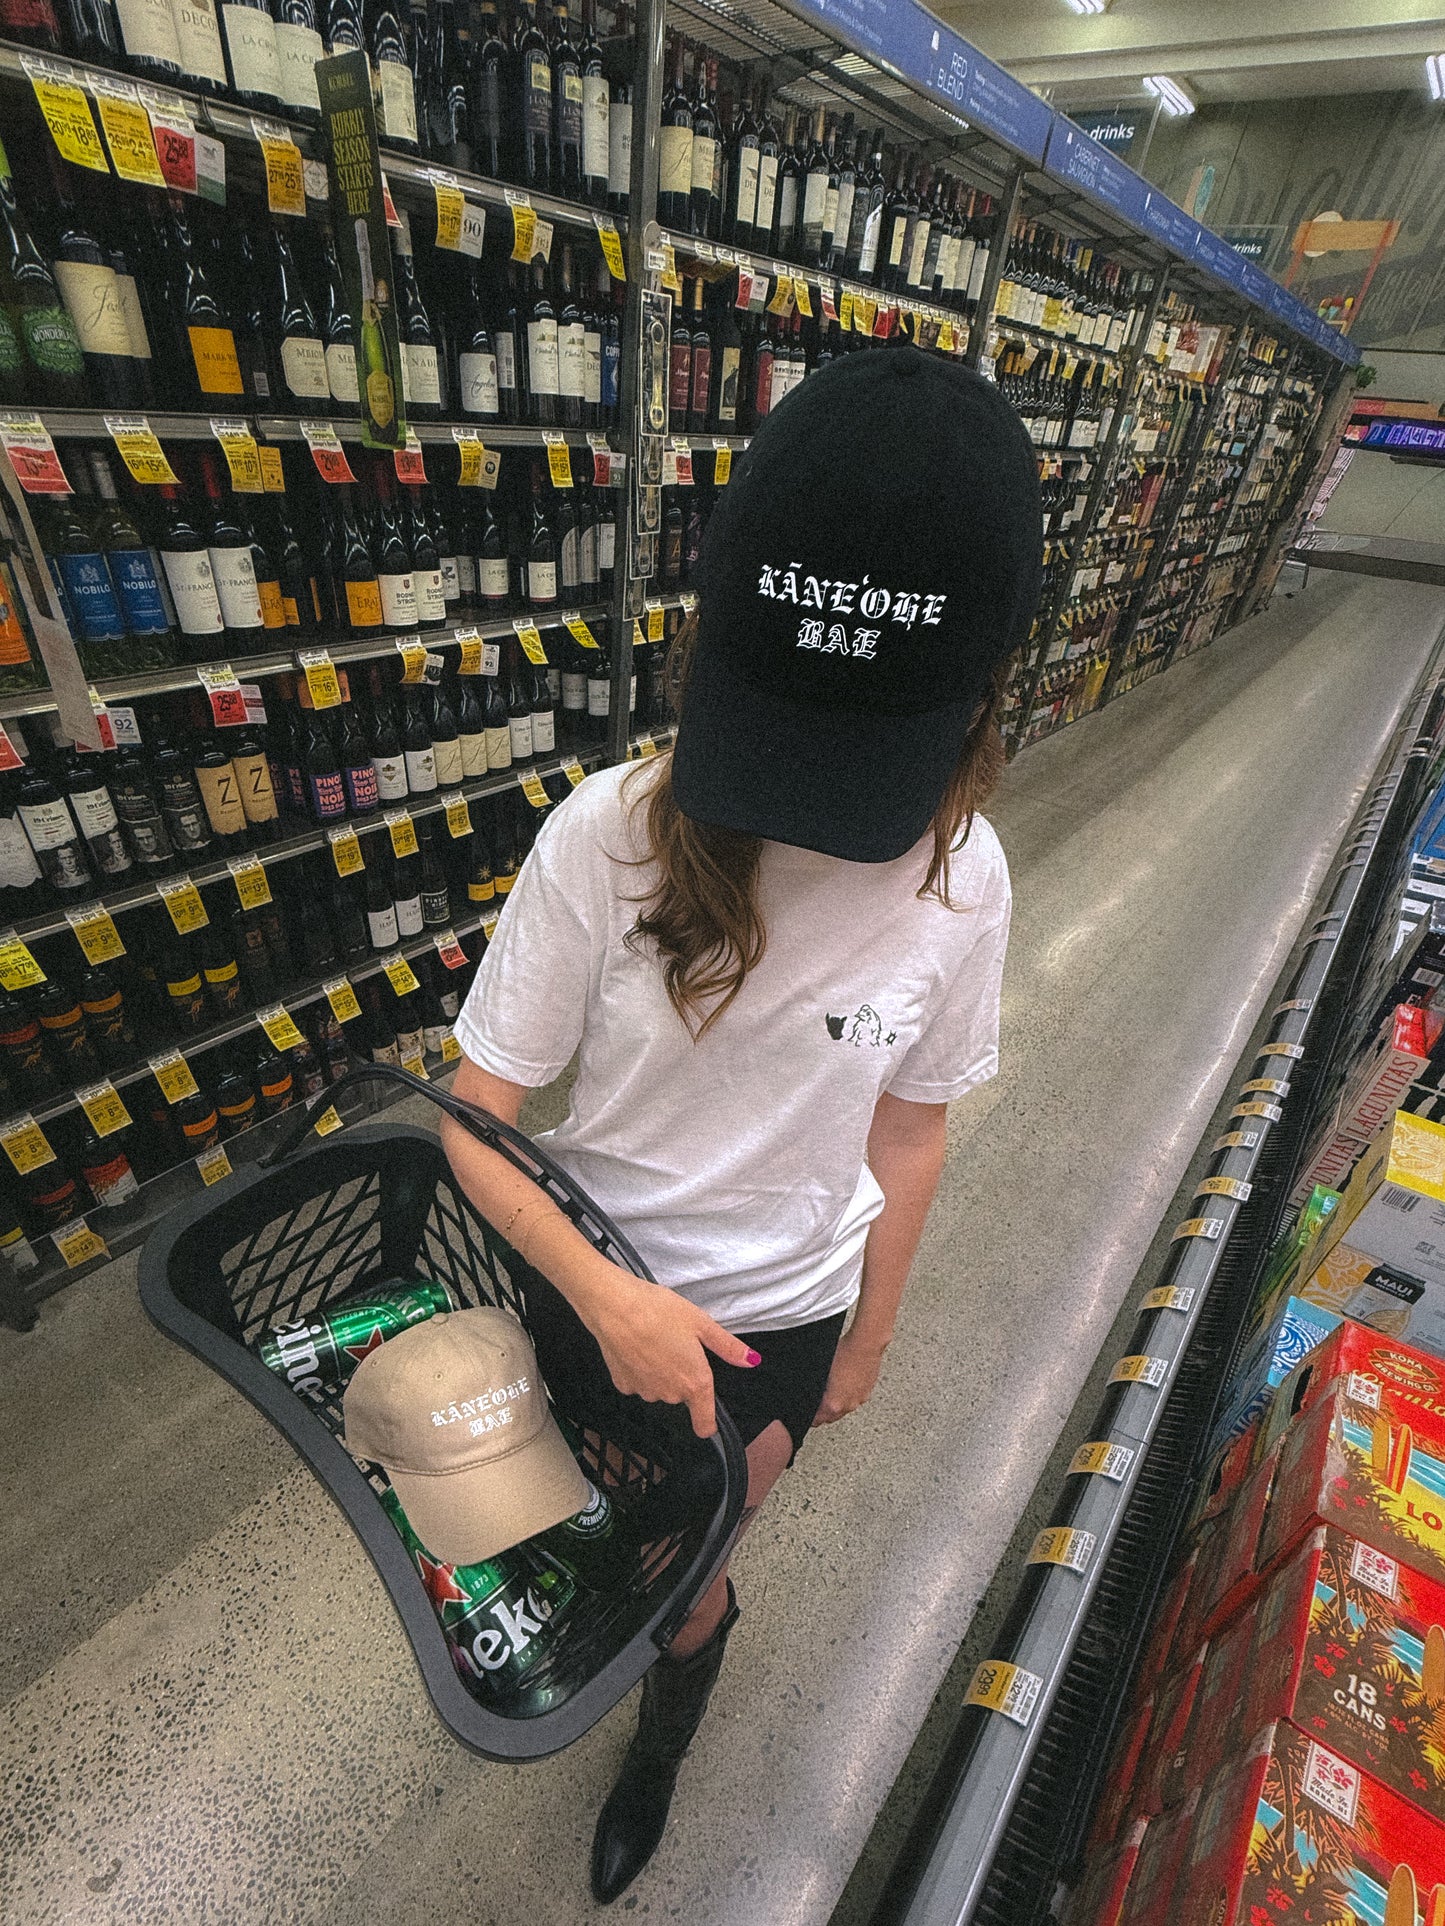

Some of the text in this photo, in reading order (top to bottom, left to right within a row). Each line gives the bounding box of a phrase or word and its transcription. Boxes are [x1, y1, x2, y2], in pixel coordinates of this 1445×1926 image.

[951, 52, 968, 79] RED
[937, 68, 964, 100] BLEND
[330, 108, 366, 138] BUBBLY
[1090, 124, 1136, 141] drinks
[333, 137, 371, 166] SEASON
[337, 163, 374, 190] STARTS
[347, 190, 371, 215] HERE
[463, 219, 482, 238] 90
[74, 584, 111, 595] NOBILO
[123, 580, 156, 589] NOBILO
[796, 617, 882, 660] BAE
[114, 719, 134, 730] 92
[217, 777, 238, 807] Z
[250, 767, 270, 794] Z
[1346, 1056, 1418, 1139] LAGUNITAS
[1375, 1275, 1413, 1297] MAUI
[1390, 1352, 1422, 1370] KONA
[1375, 1363, 1422, 1389] BREWING
[1406, 1501, 1443, 1530] LO
[471, 1575, 489, 1591] 1873
[1348, 1674, 1378, 1705] 18
[1334, 1689, 1386, 1731] CANS
